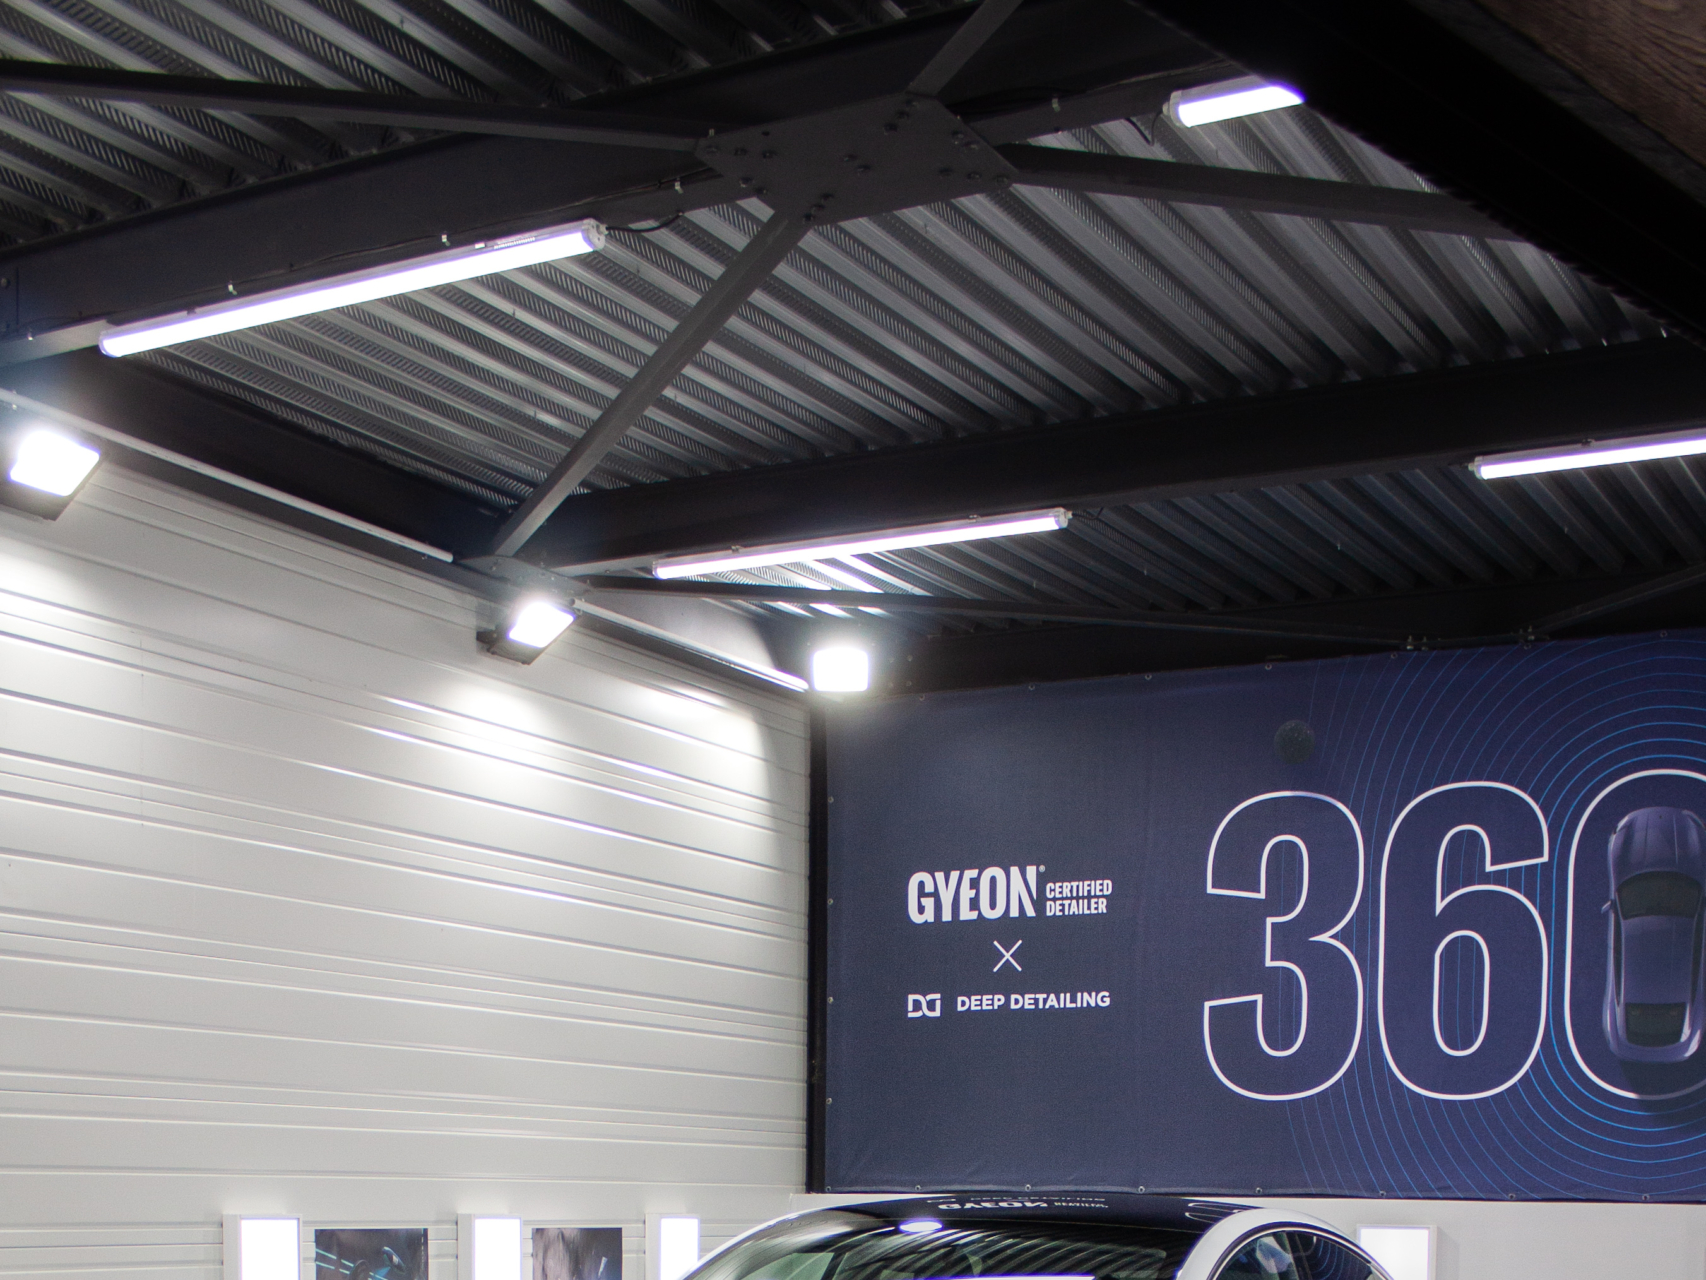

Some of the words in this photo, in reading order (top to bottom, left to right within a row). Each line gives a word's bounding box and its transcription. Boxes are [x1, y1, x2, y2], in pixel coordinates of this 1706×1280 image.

[1046, 879, 1113, 898] CERTIFIED
[1046, 898, 1108, 916] DETAILER
[1203, 767, 1706, 1102] 360
[956, 994, 1006, 1011] DEEP
[1010, 991, 1111, 1010] DETAILING
